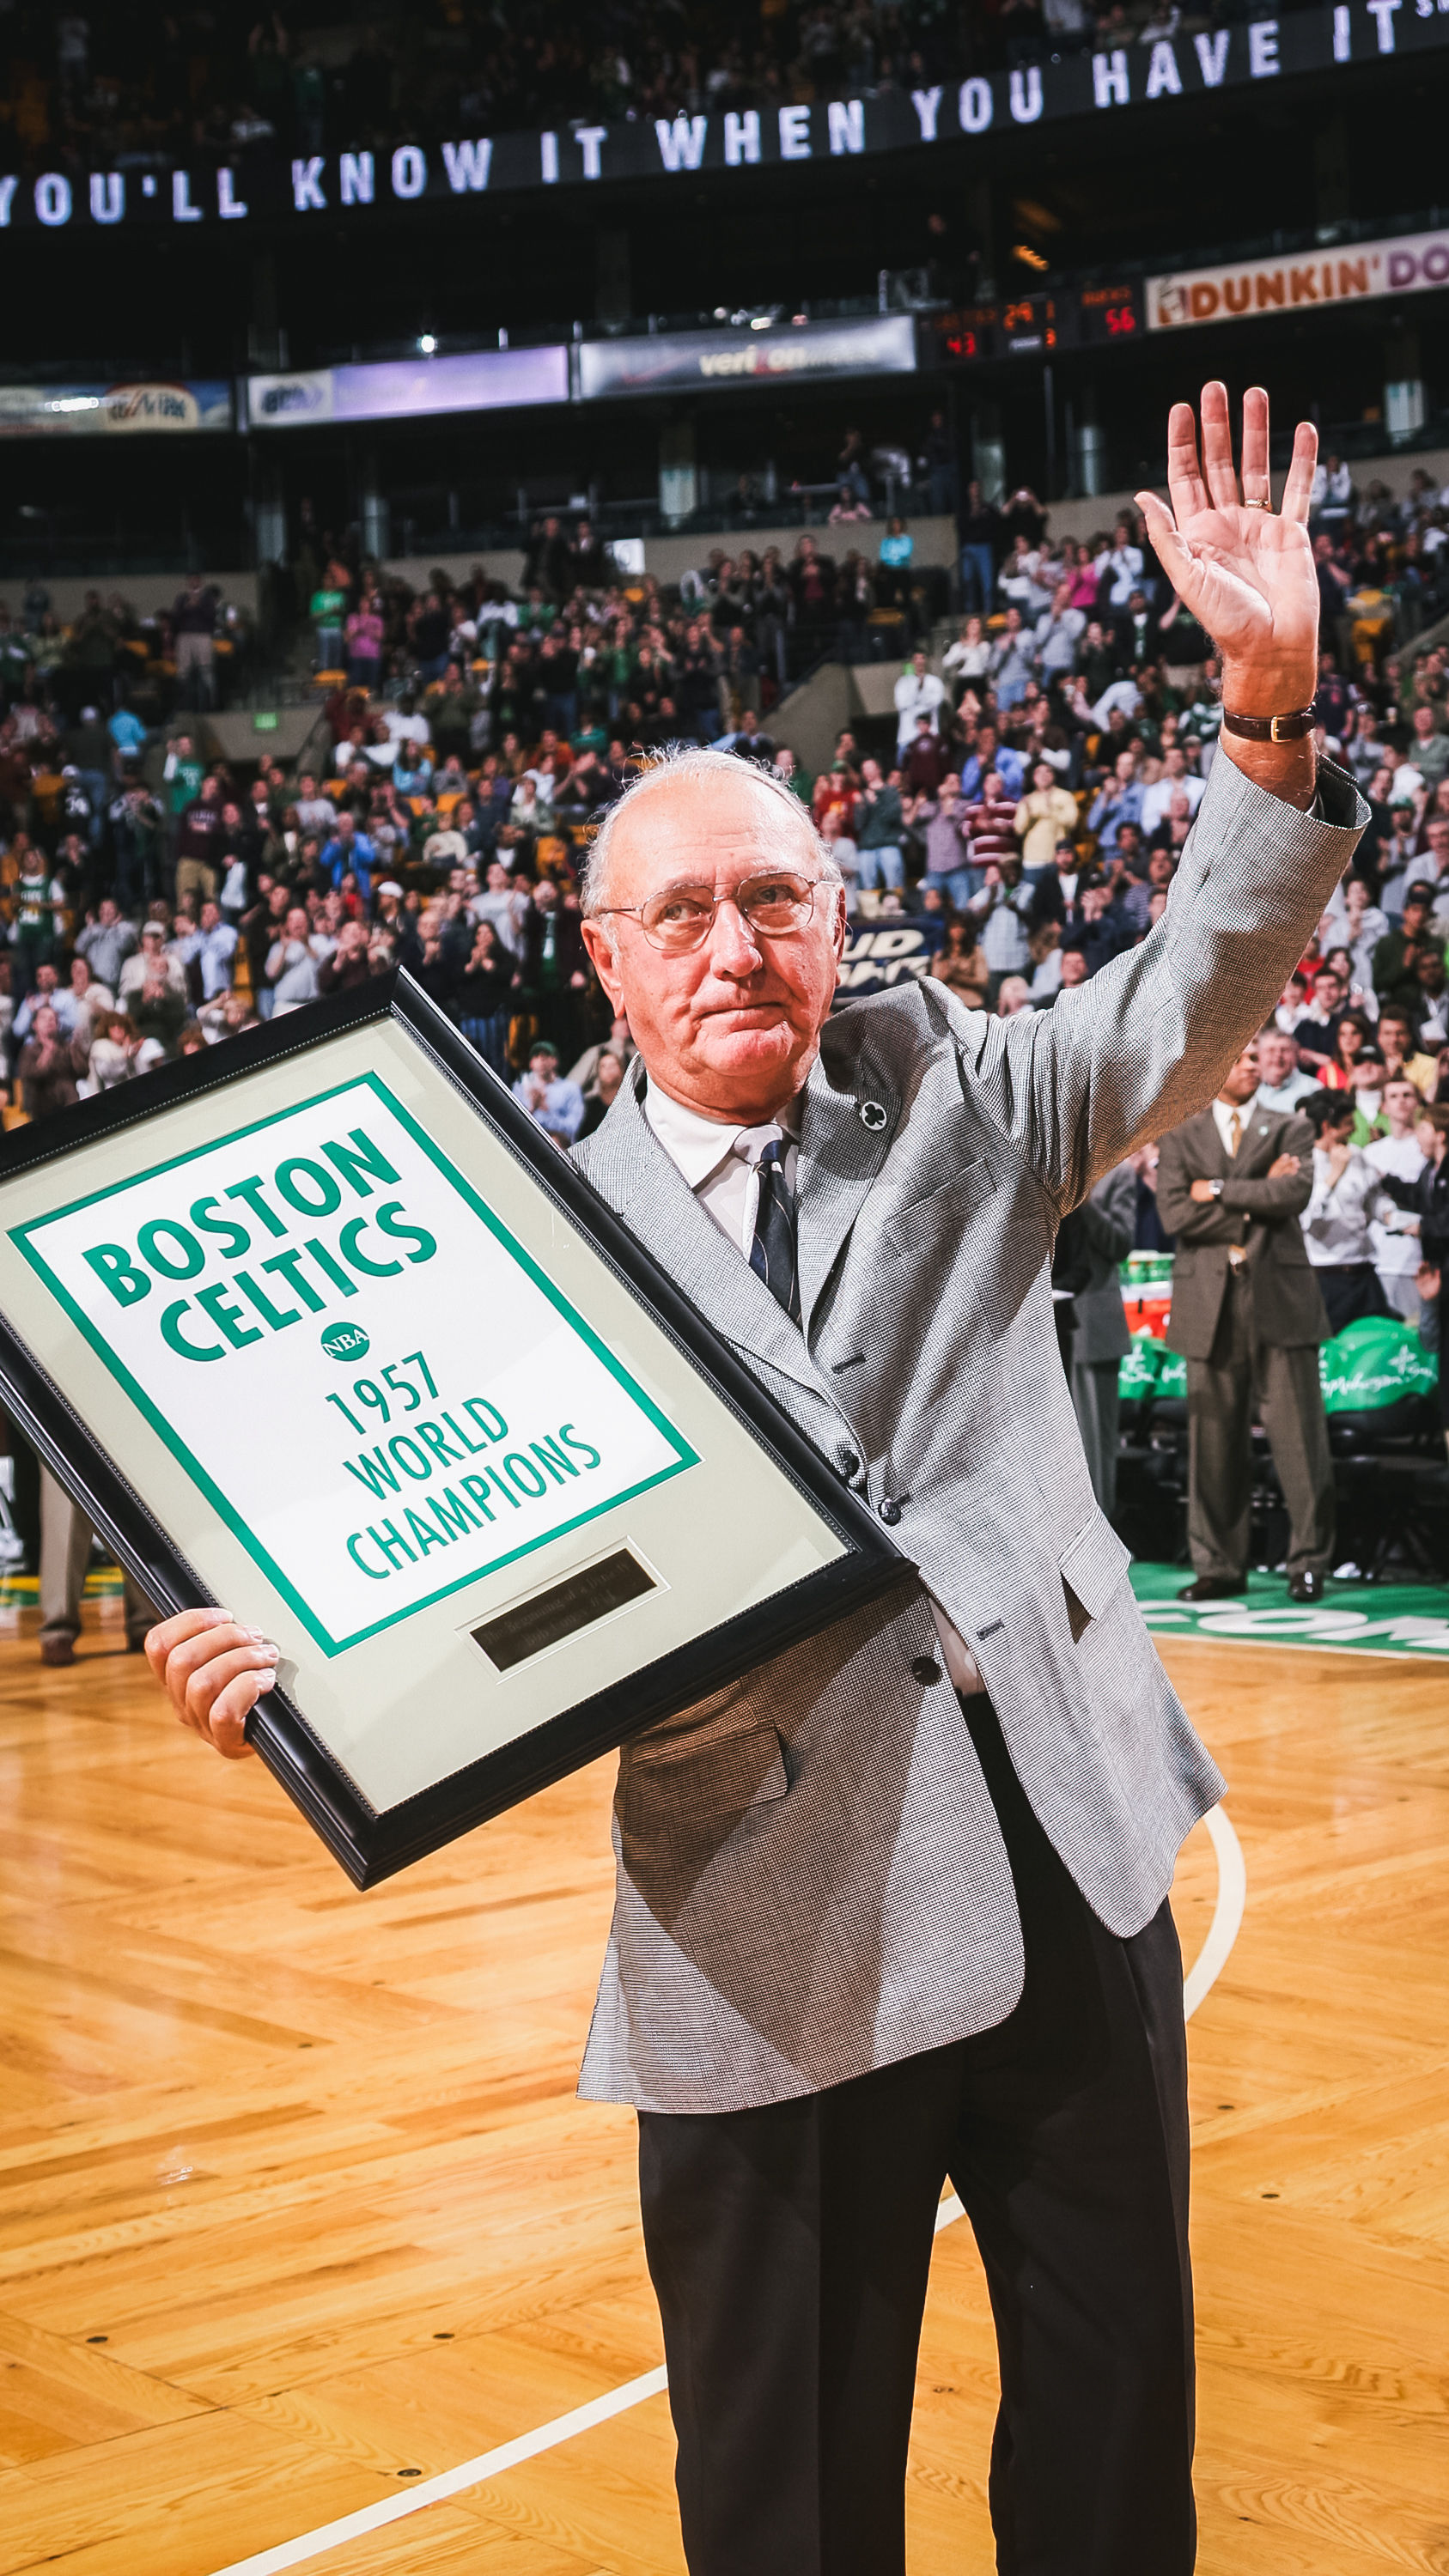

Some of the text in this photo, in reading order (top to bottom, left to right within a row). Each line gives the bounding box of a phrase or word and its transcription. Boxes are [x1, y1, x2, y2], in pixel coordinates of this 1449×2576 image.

[0, 168, 248, 228] YOU'LL
[292, 137, 494, 212] KNOW
[541, 125, 608, 185] IT
[654, 100, 866, 173] WHEN
[911, 65, 1044, 143] YOU
[1093, 19, 1282, 109] HAVE
[1333, 0, 1403, 64] IT
[1105, 307, 1135, 335] 56
[1189, 244, 1449, 319] DUNKIN' DO
[947, 331, 976, 357] 43
[841, 930, 925, 961] UD
[82, 1128, 401, 1307] BOSTON
[161, 1202, 437, 1361] CELTICS
[321, 1328, 369, 1358] NBA
[326, 1352, 439, 1434] 1957
[344, 1398, 508, 1499] WORLD
[347, 1425, 600, 1579] CHAMPIONS
